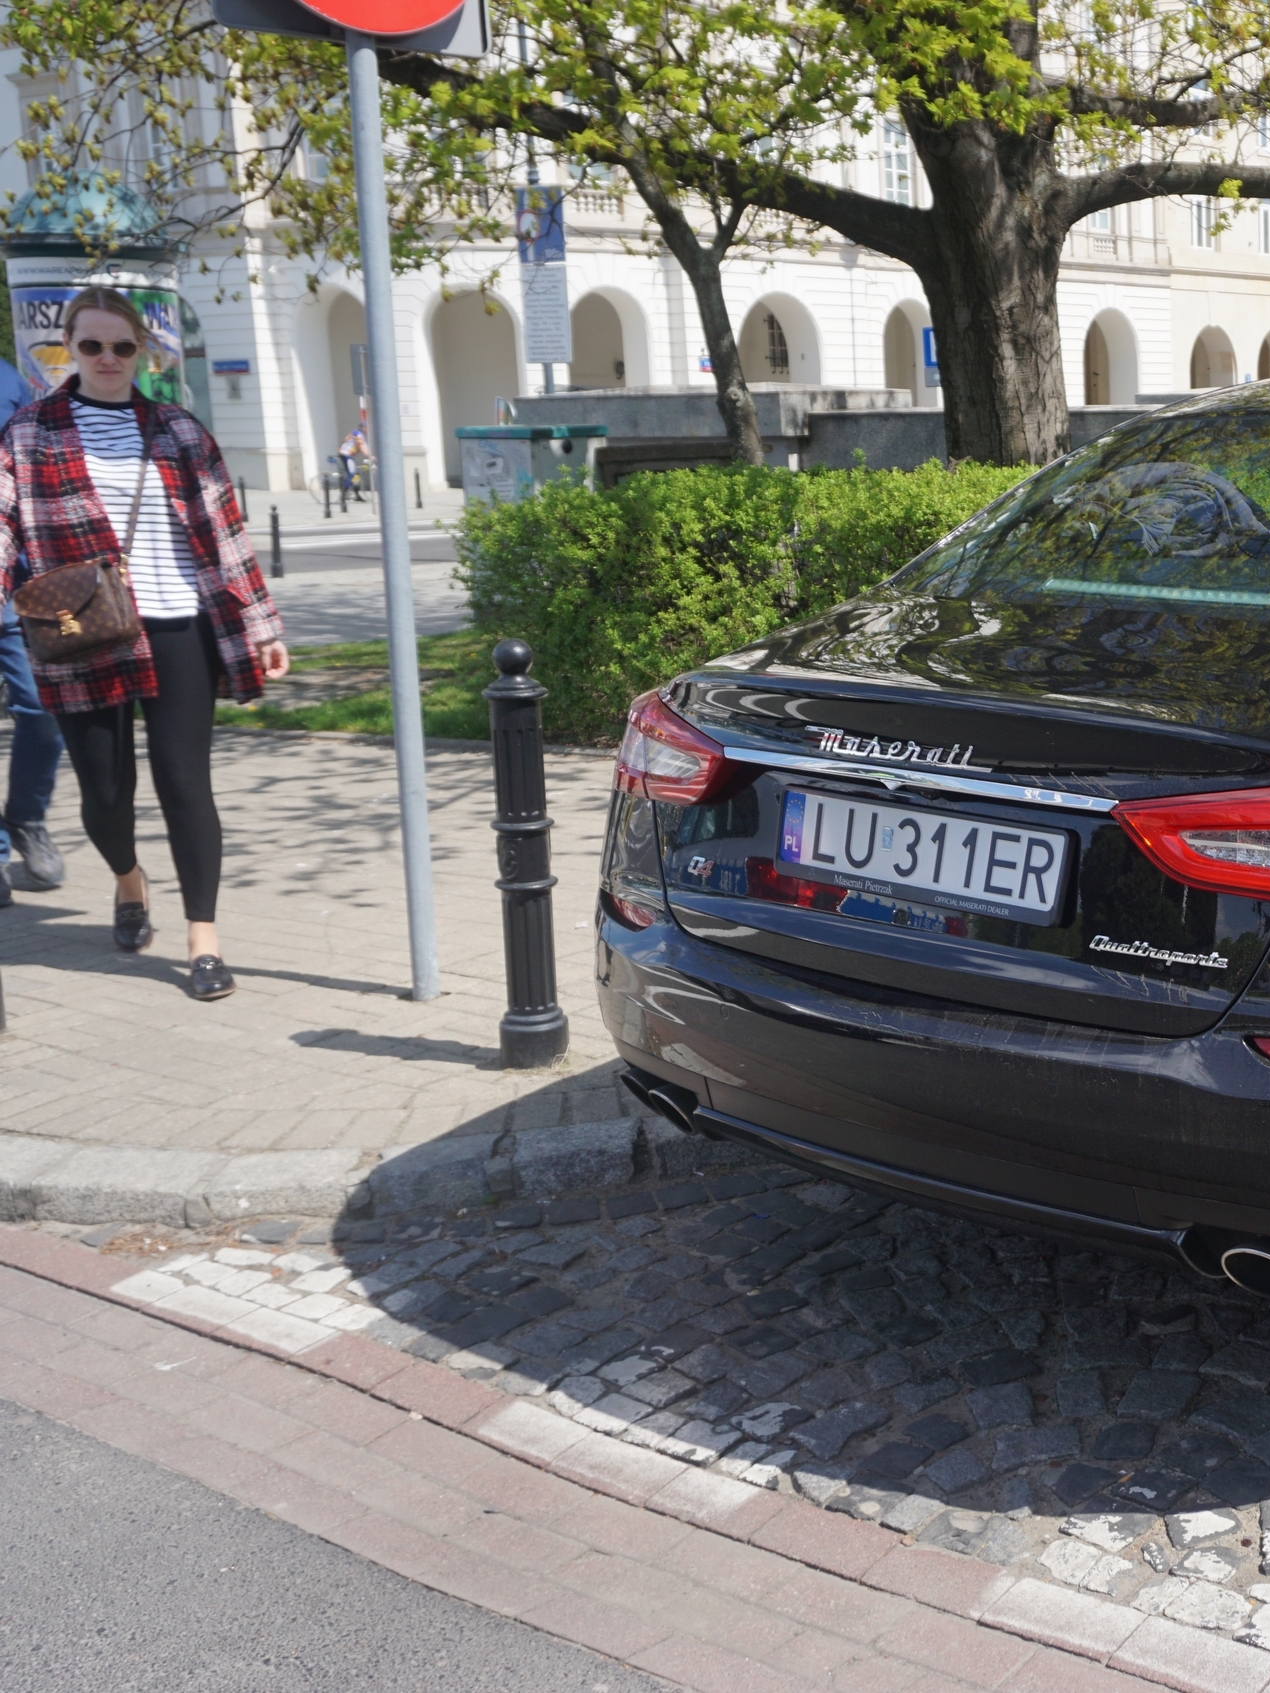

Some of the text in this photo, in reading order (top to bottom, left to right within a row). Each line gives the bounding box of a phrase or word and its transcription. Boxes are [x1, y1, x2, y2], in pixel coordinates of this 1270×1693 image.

[805, 725, 993, 773] Maserati
[784, 835, 800, 852] PL
[811, 803, 1055, 904] LU 311ER
[688, 856, 714, 878] Q4
[833, 874, 894, 895] Maserati Pietrzak
[934, 896, 1010, 916] OFFICIAL MASERATI DEALER
[1089, 934, 1228, 968] Quattroporte
